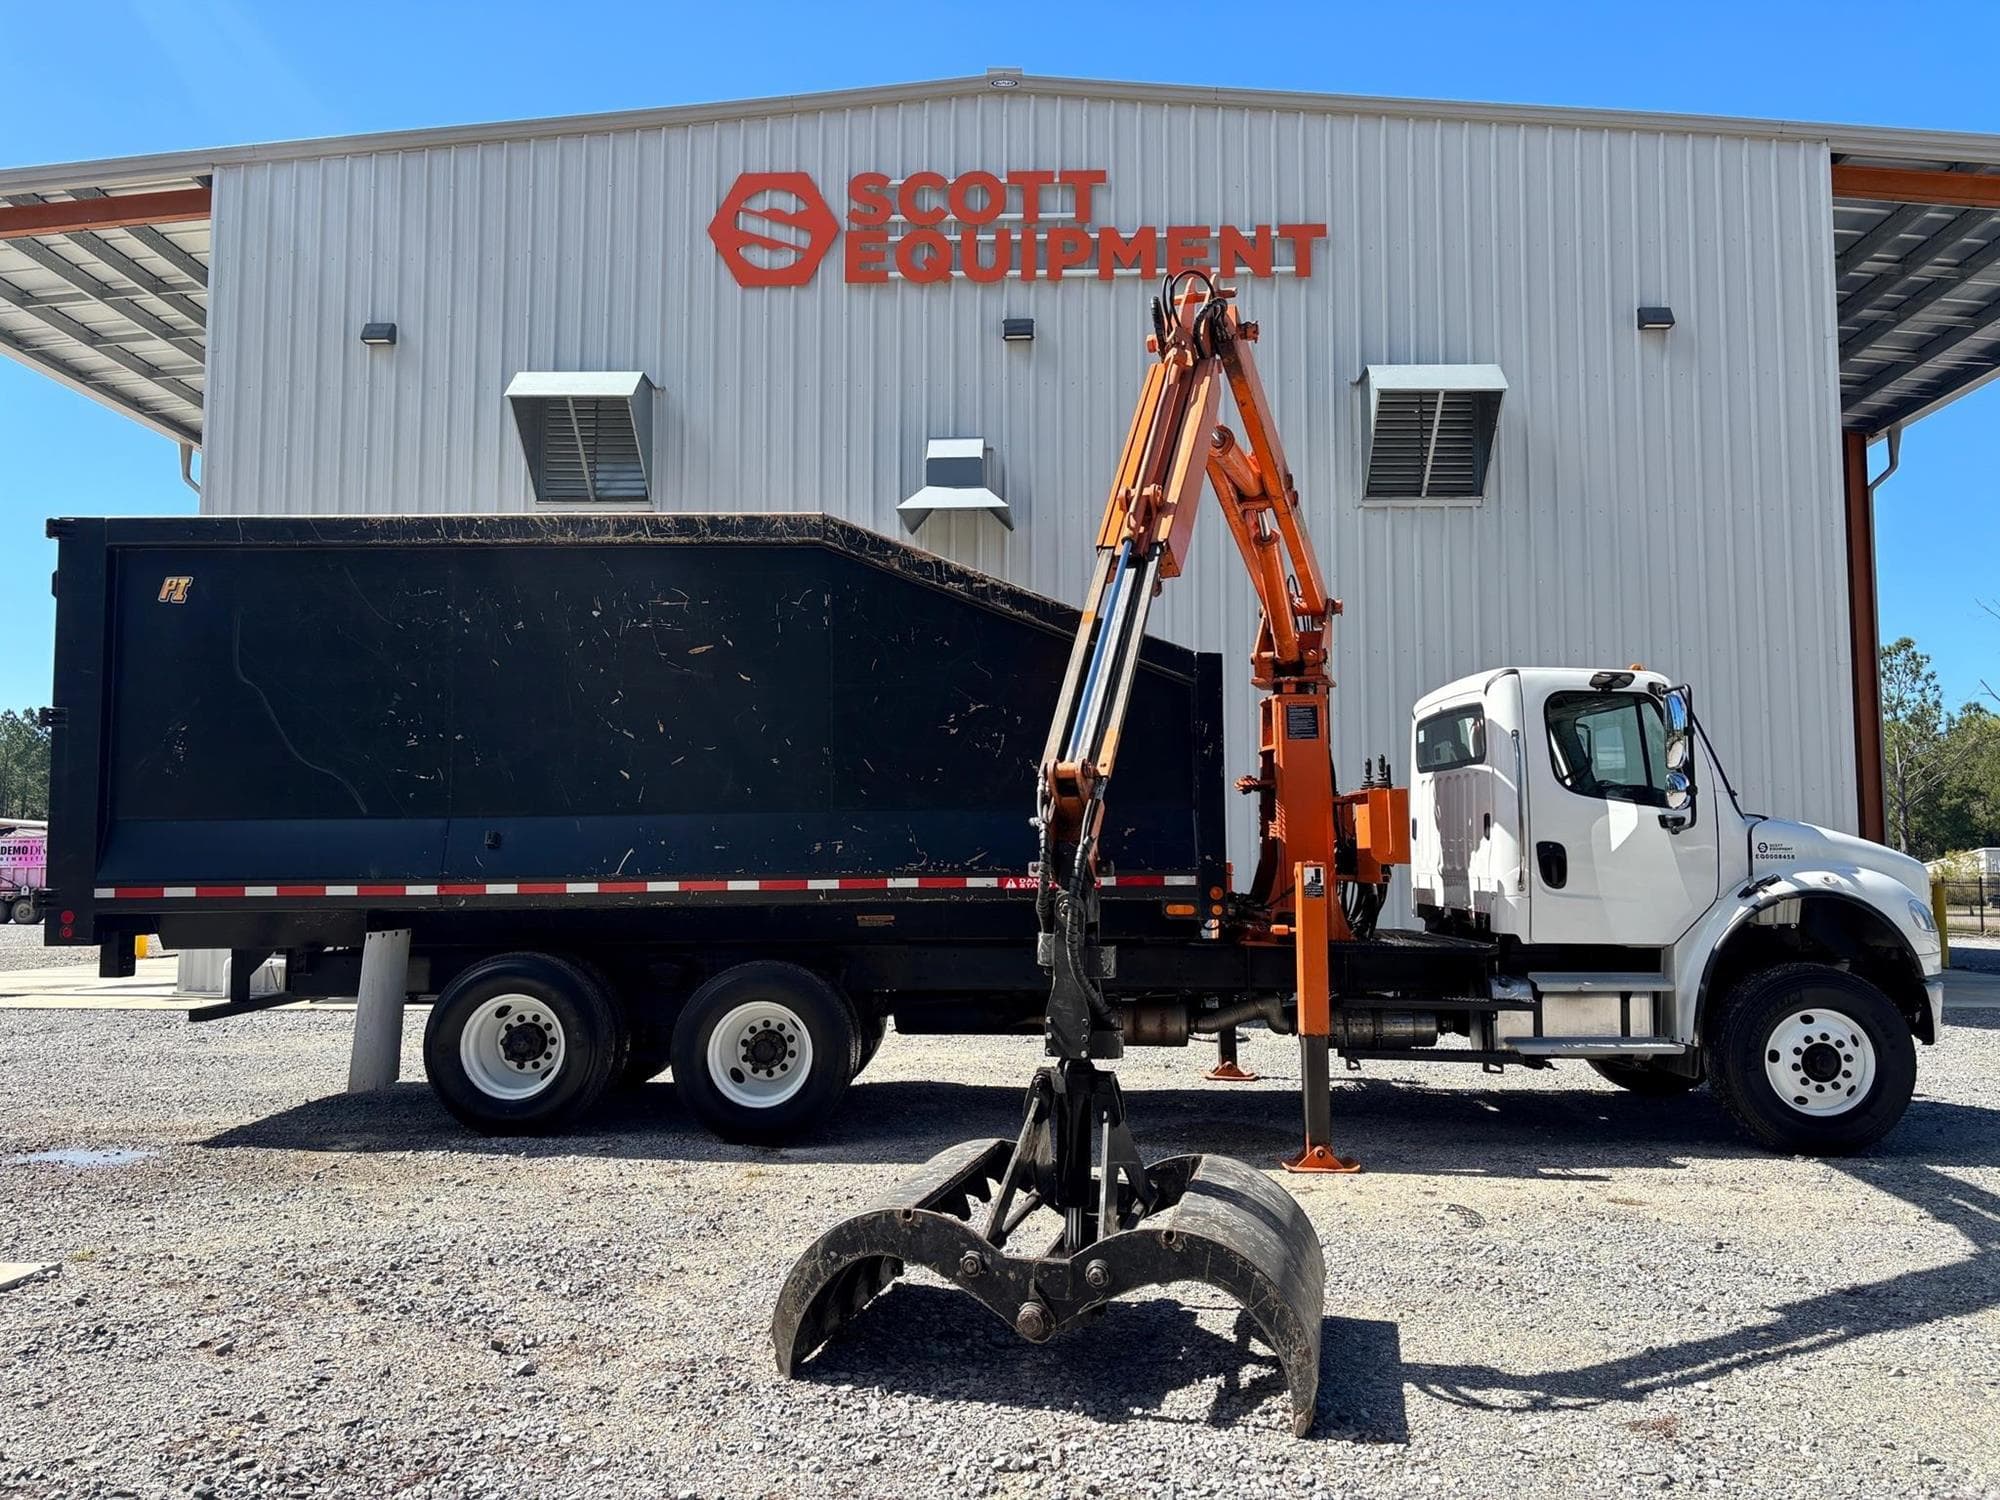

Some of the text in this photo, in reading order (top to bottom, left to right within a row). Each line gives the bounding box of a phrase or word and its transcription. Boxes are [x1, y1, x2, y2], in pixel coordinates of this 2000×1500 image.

[847, 171, 1106, 225] SCOTT
[845, 223, 1327, 283] EQUIPMENT
[1, 845, 29, 856] DEMO
